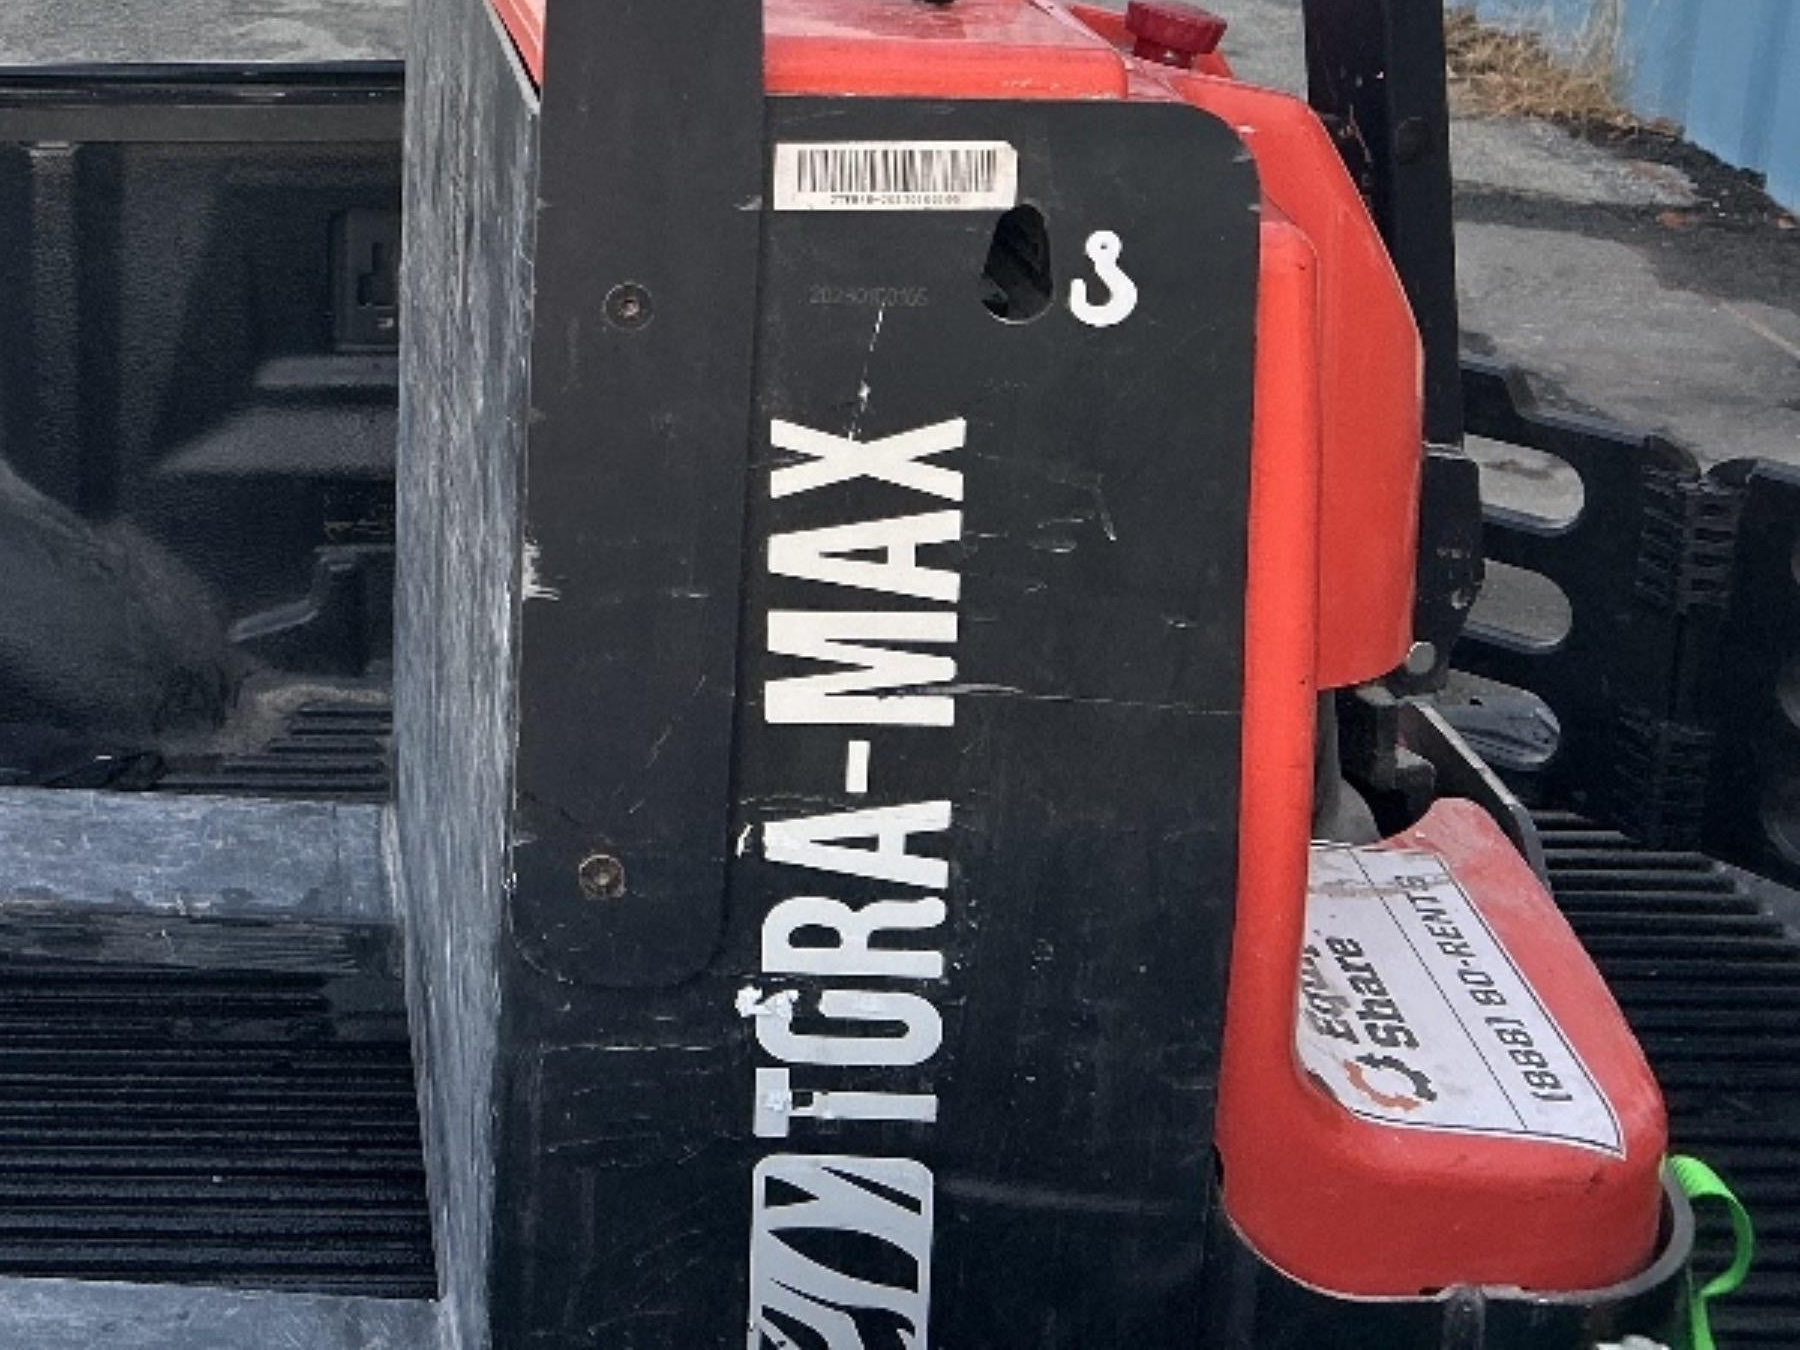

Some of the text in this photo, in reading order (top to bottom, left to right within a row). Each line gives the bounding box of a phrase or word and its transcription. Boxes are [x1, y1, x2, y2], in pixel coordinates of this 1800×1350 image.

[753, 417, 967, 1138] TORA-MAX
[1325, 936, 1420, 1050] Share
[1485, 1014, 1574, 1103] (888)
